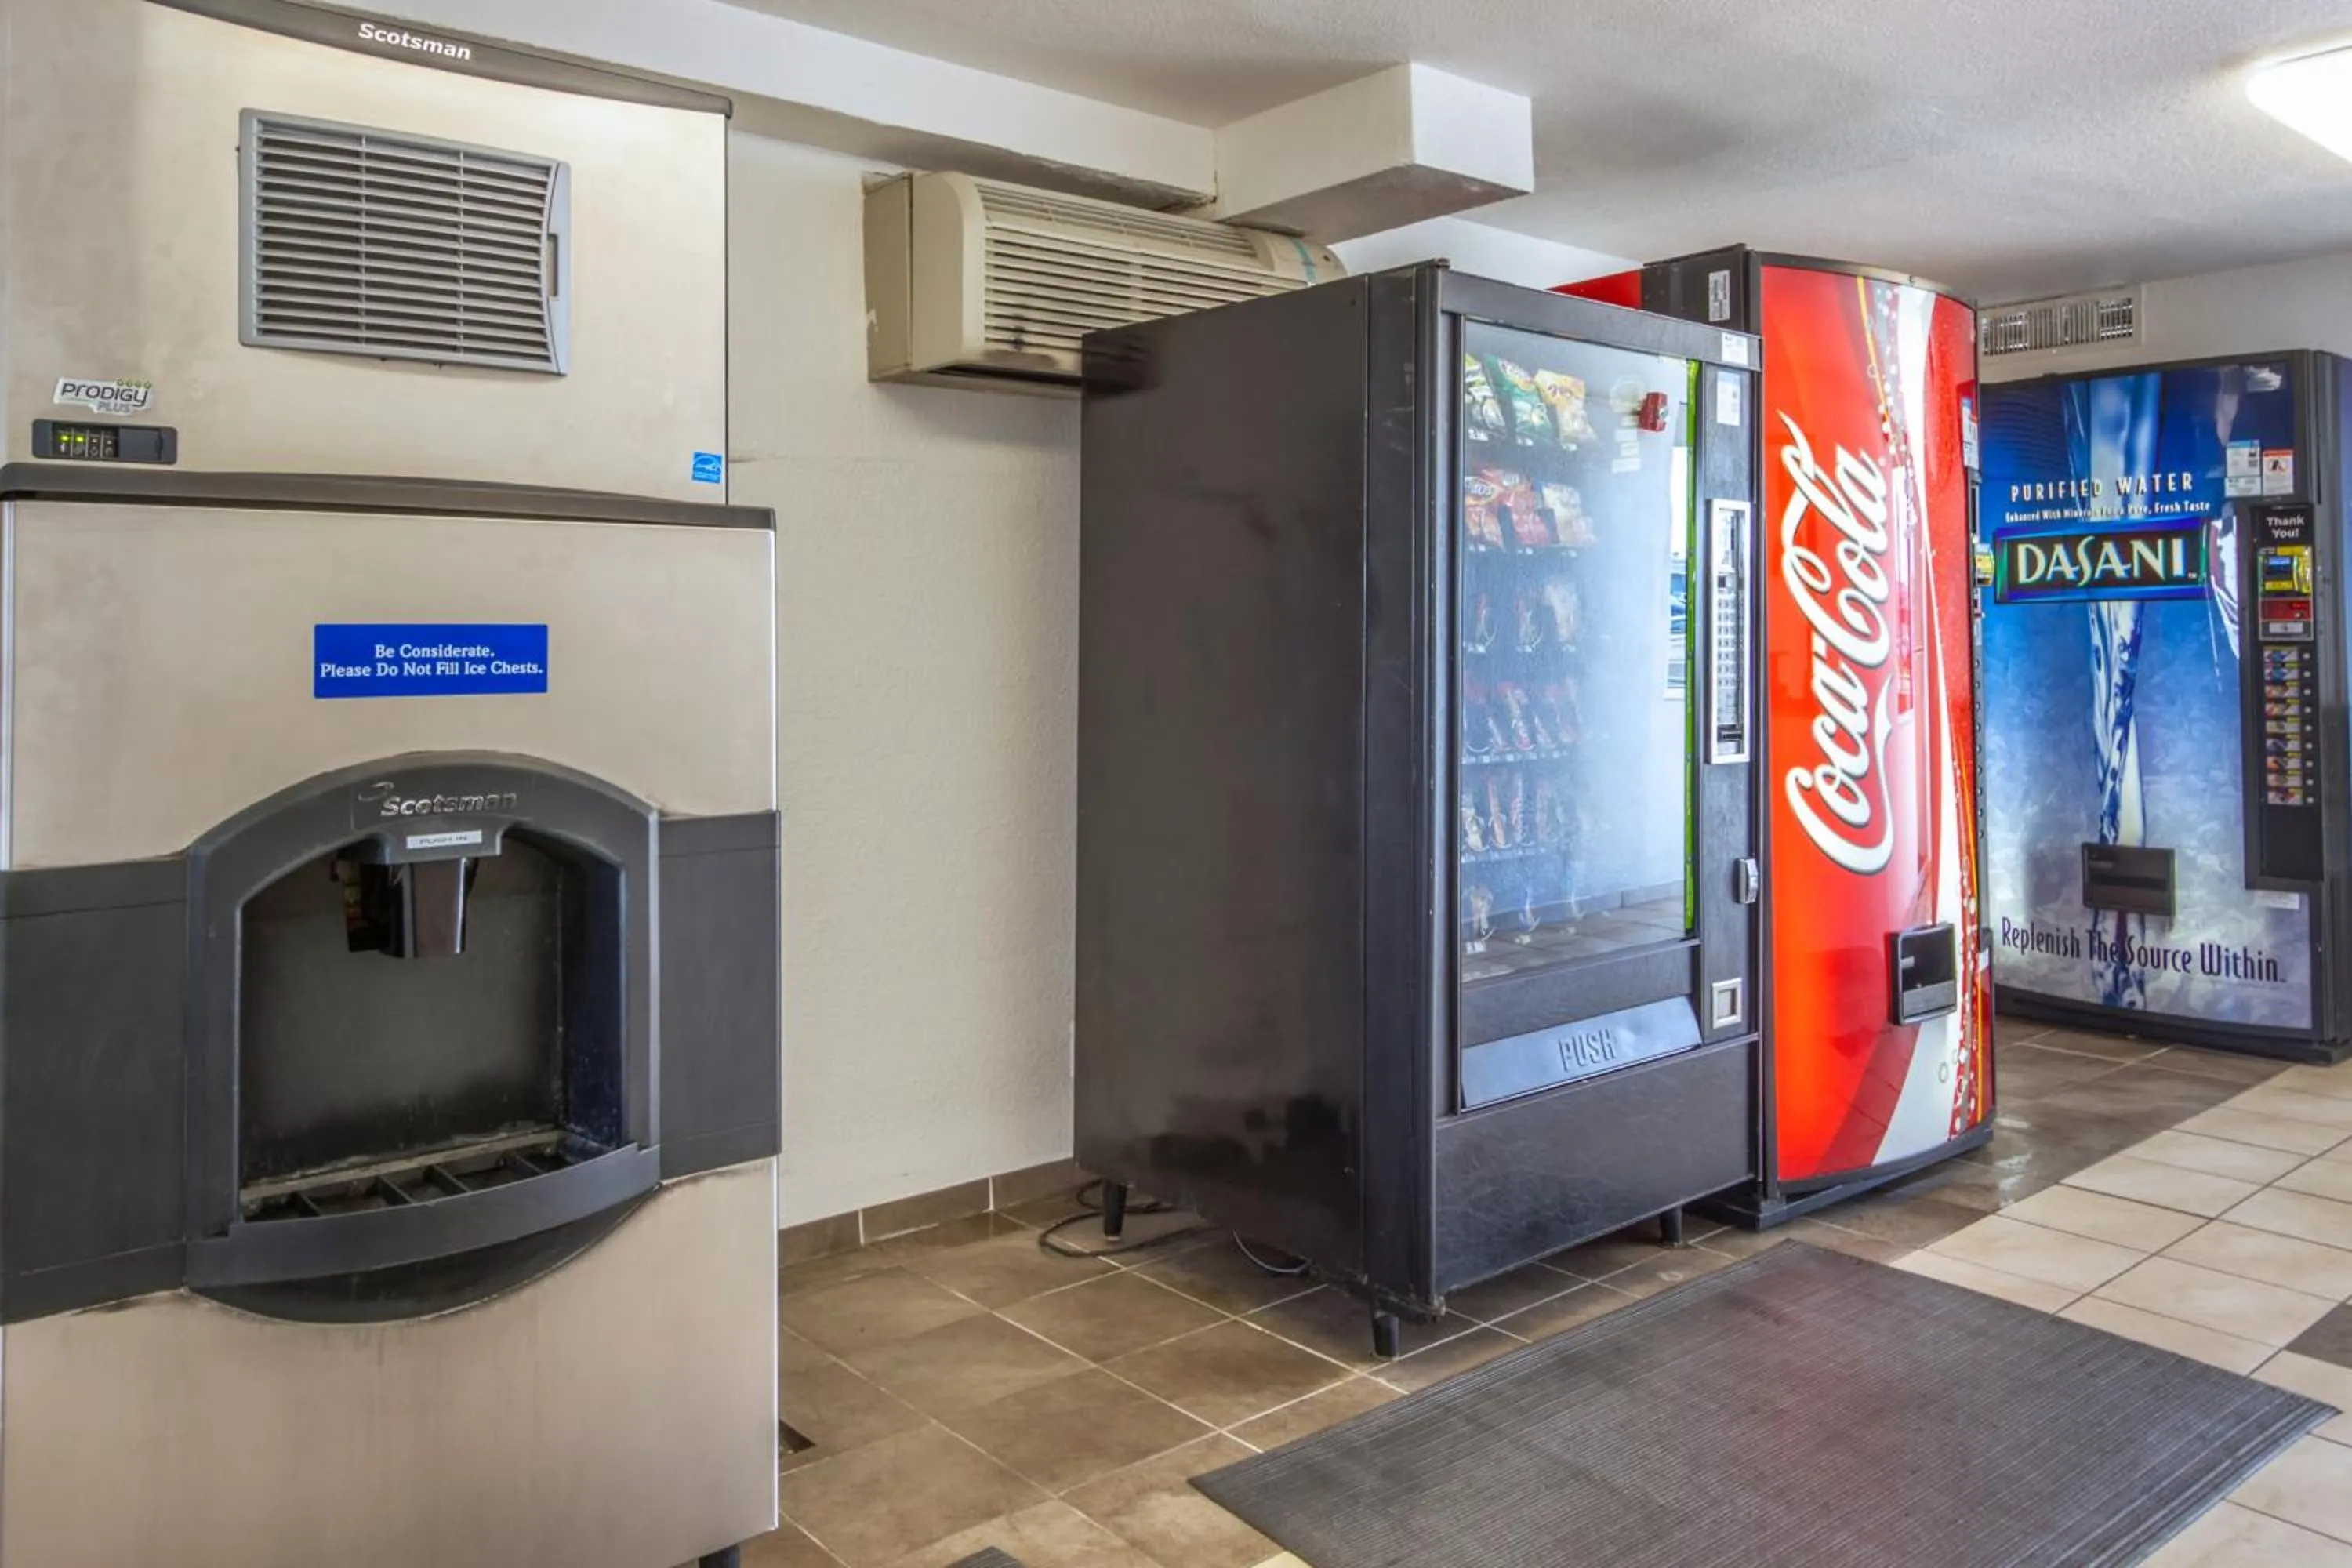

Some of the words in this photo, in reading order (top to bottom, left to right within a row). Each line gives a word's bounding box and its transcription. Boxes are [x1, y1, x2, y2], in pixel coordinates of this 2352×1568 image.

[358, 23, 471, 60] Scotsman
[97, 401, 131, 413] PLUS
[2010, 478, 2103, 503] PURIFIED
[2117, 472, 2194, 496] WATER
[2005, 510, 2040, 523] Enhanced
[2042, 509, 2061, 520] With
[2154, 502, 2180, 513] Fresh
[2183, 499, 2210, 512] Taste
[2267, 514, 2305, 526] Thank
[2272, 528, 2299, 538] You!
[2017, 535, 2185, 586] DASANI
[375, 644, 395, 659] Be
[399, 643, 495, 658] Considerate.
[320, 663, 372, 677] Please
[376, 662, 398, 677] Do
[403, 662, 431, 676] Not
[436, 661, 459, 675] Fill
[464, 661, 487, 675] Ice
[490, 660, 544, 674] Chests.
[380, 792, 517, 816] Scotsman
[2002, 916, 2080, 959] Replenish
[2085, 928, 2119, 964] The
[2127, 935, 2192, 974] Source
[1558, 1028, 1616, 1072] PUSH
